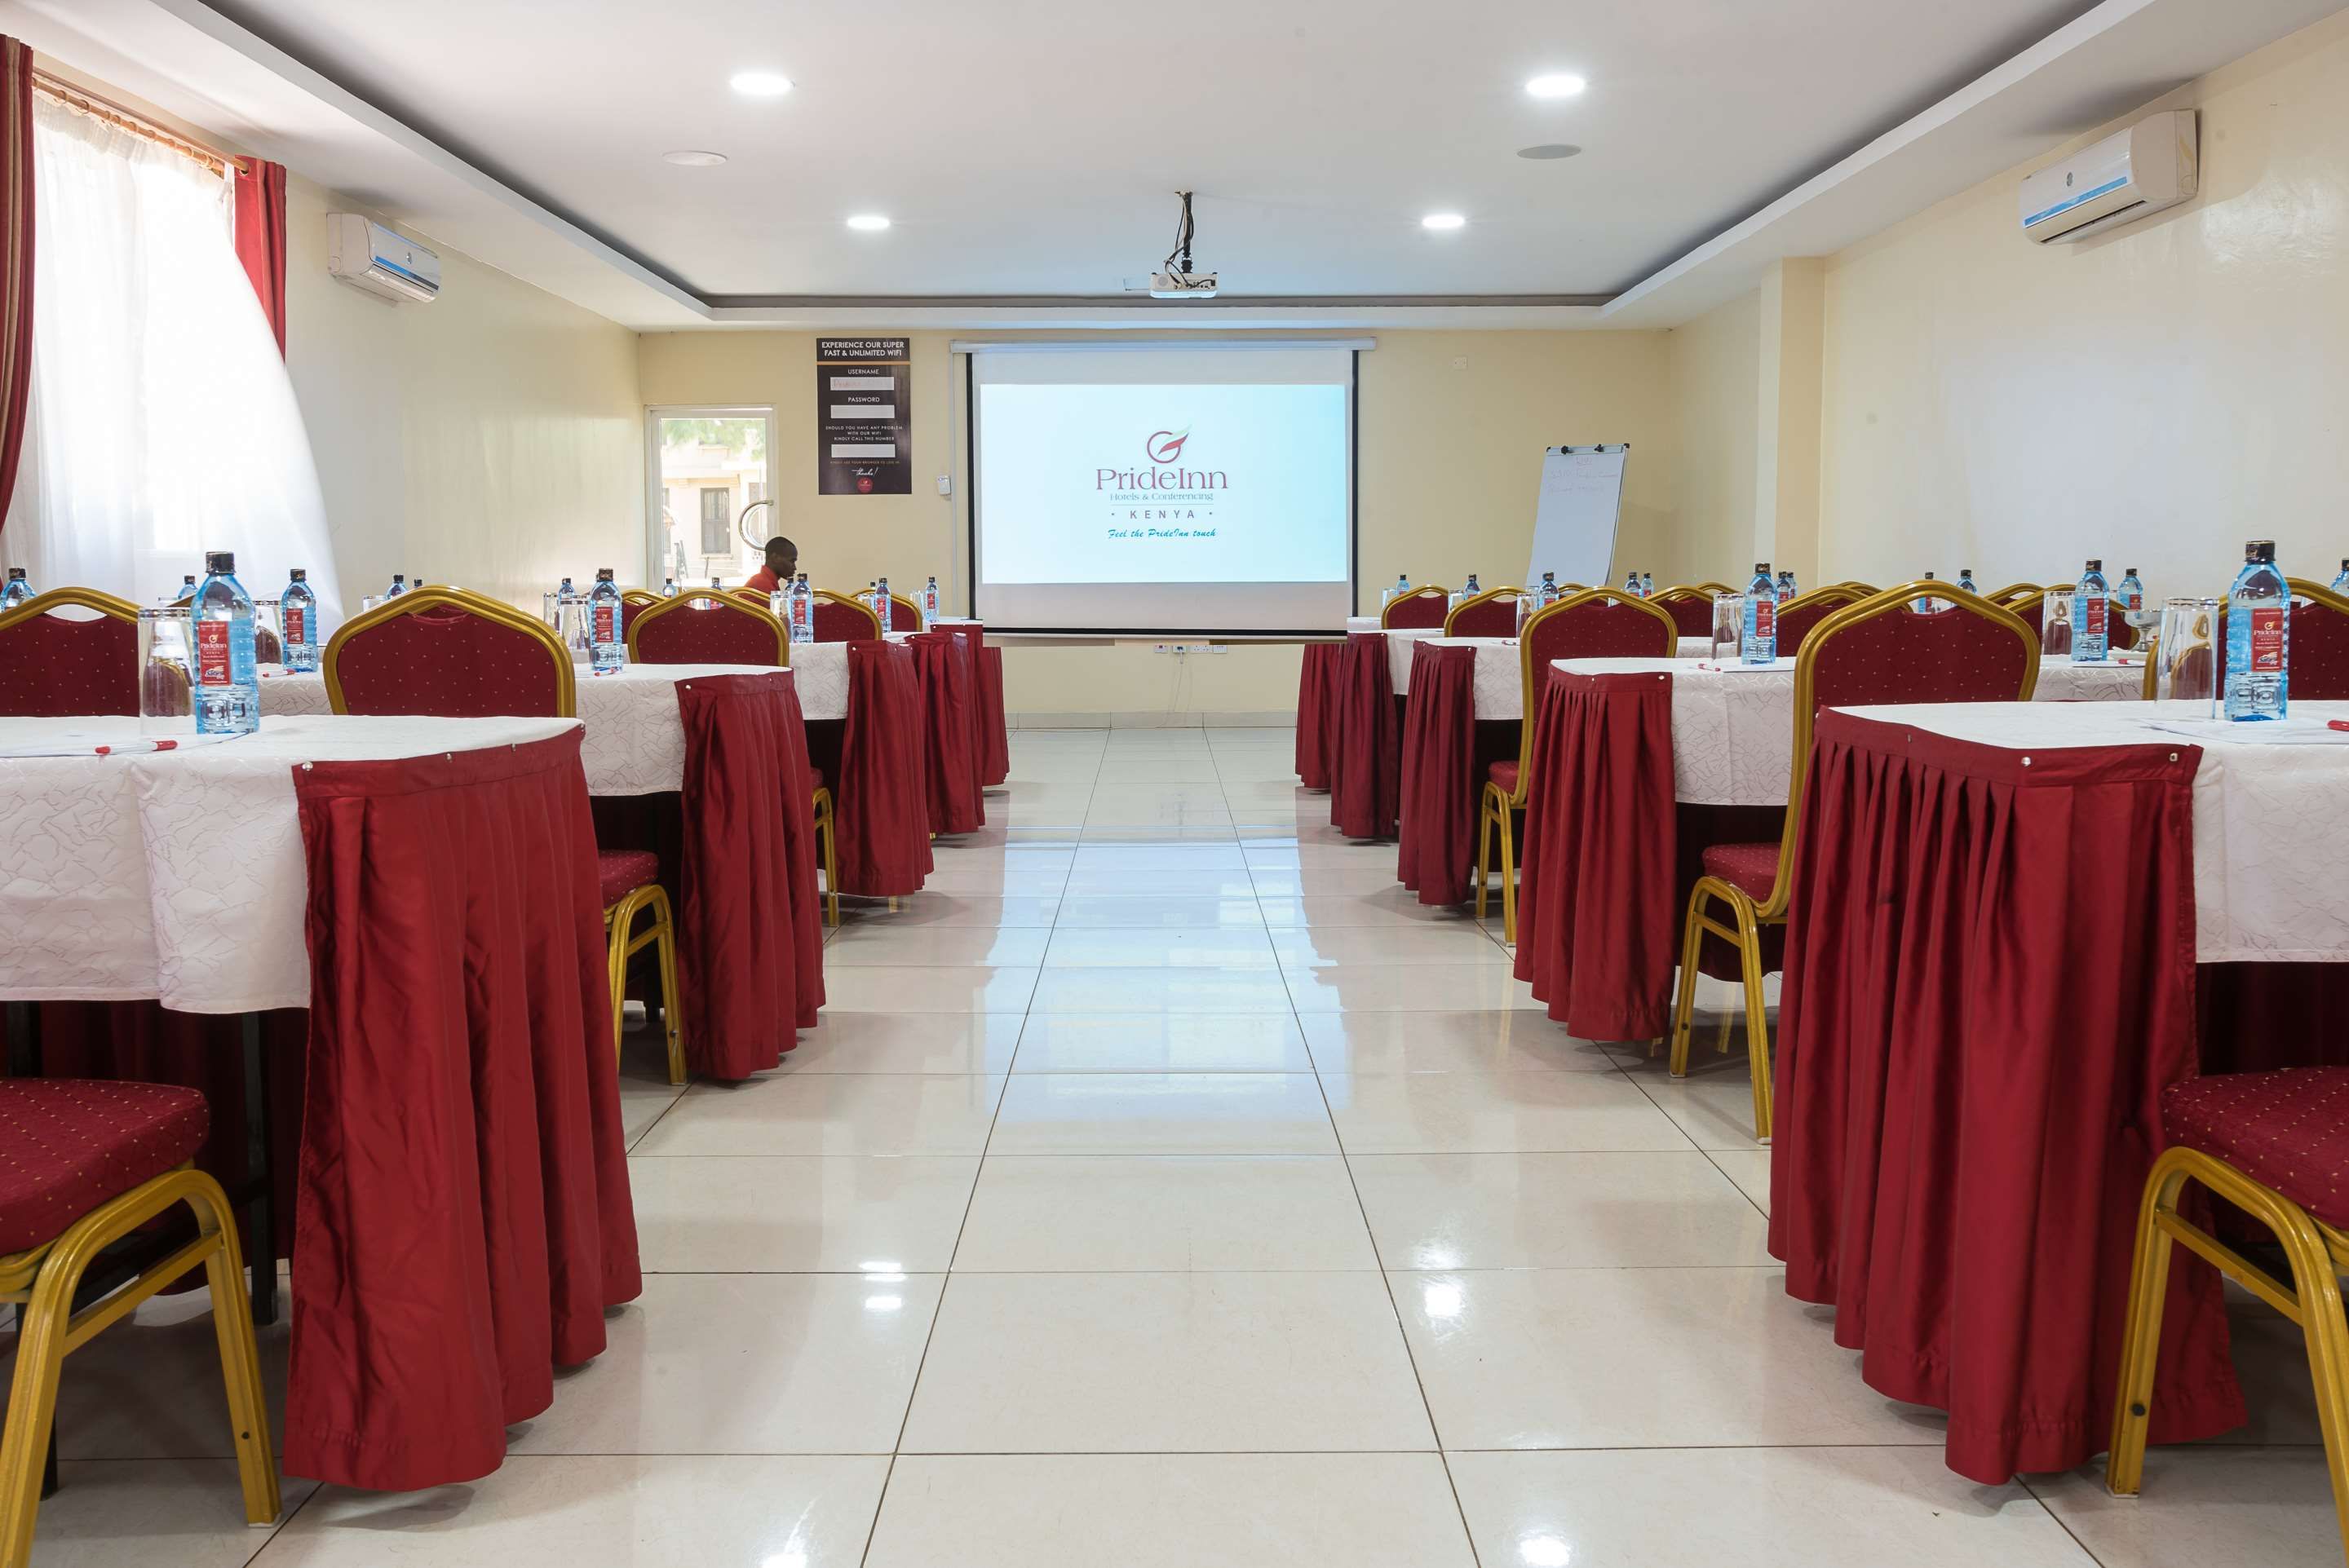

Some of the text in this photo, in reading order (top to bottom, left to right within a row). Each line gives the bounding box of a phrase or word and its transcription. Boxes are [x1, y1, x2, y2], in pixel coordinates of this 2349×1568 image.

[1096, 466, 1229, 490] PrideInn
[1110, 492, 1139, 501] Hotels
[1151, 492, 1214, 501] Conferencing
[1130, 510, 1195, 519] KENYA
[1108, 528, 1216, 538] Feel the PrideInn touch
